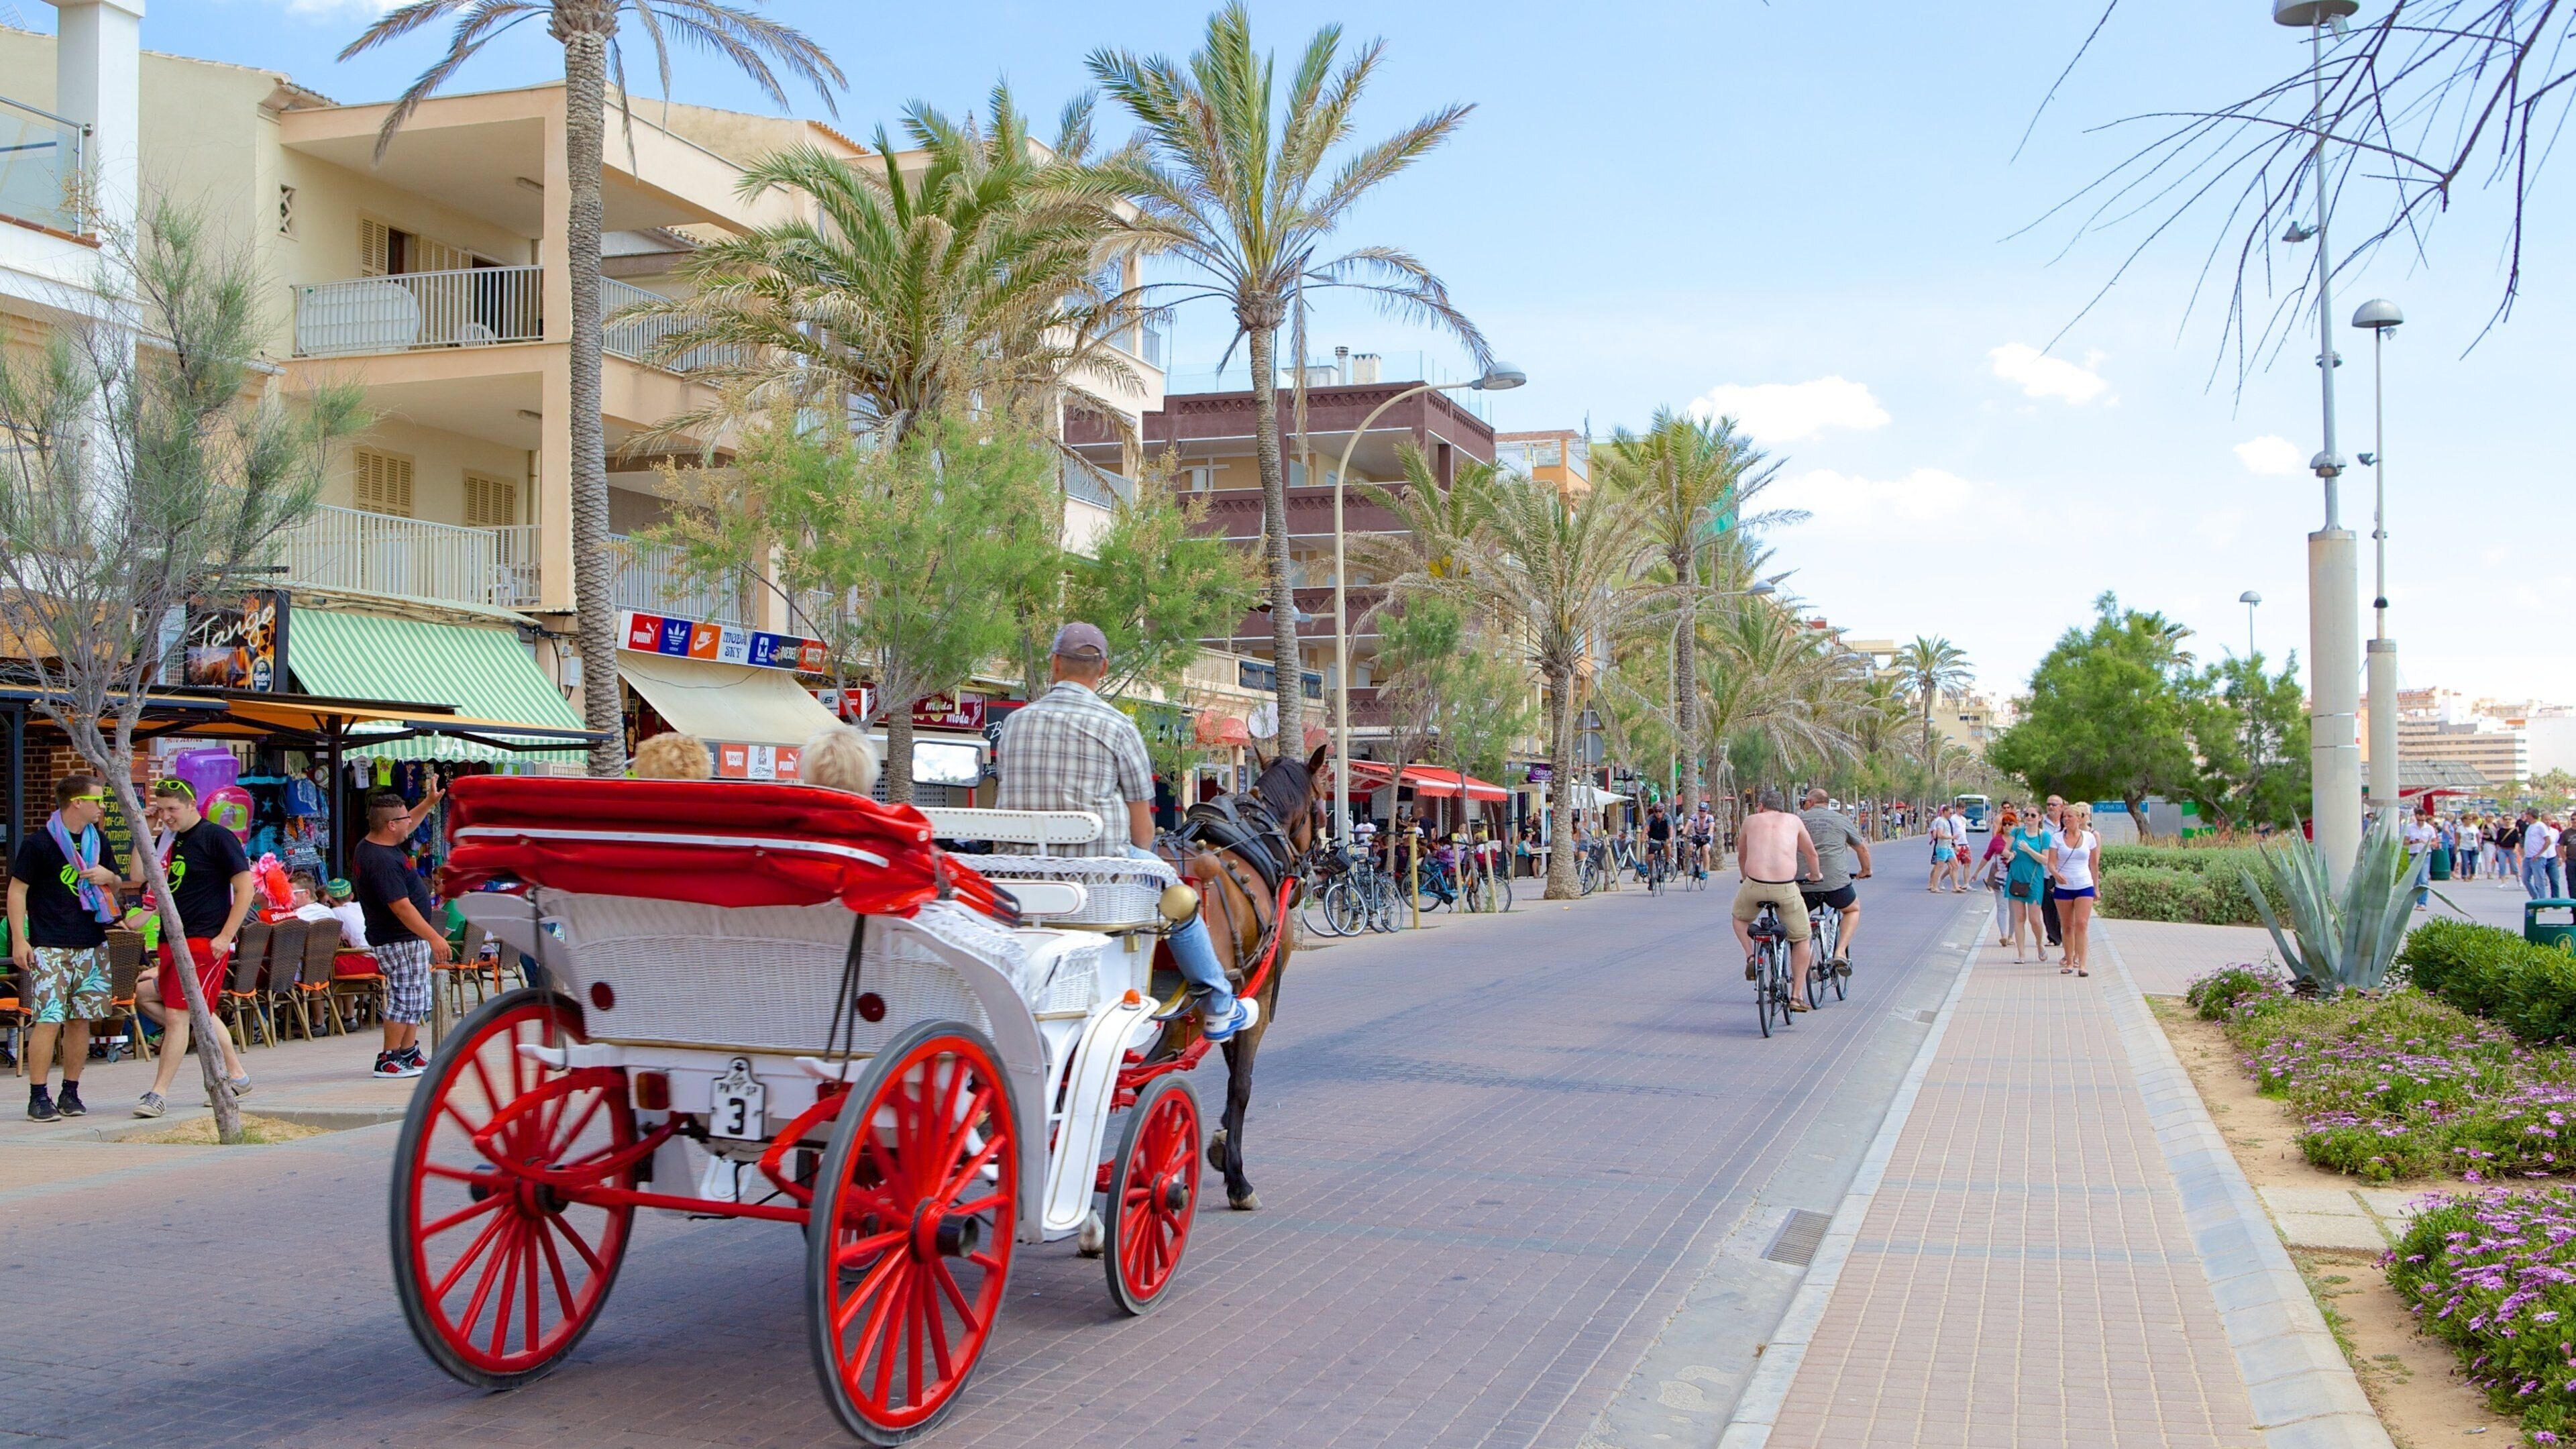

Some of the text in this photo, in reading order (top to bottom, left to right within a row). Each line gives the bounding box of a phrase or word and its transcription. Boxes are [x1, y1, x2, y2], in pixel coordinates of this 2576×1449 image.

[190, 606, 274, 652] Tango
[632, 631, 652, 644] PUMA
[723, 632, 747, 645] MODA
[725, 646, 742, 658] SKY
[947, 711, 969, 724] Moda
[778, 761, 795, 771] PUMA
[727, 1097, 745, 1135] 3
